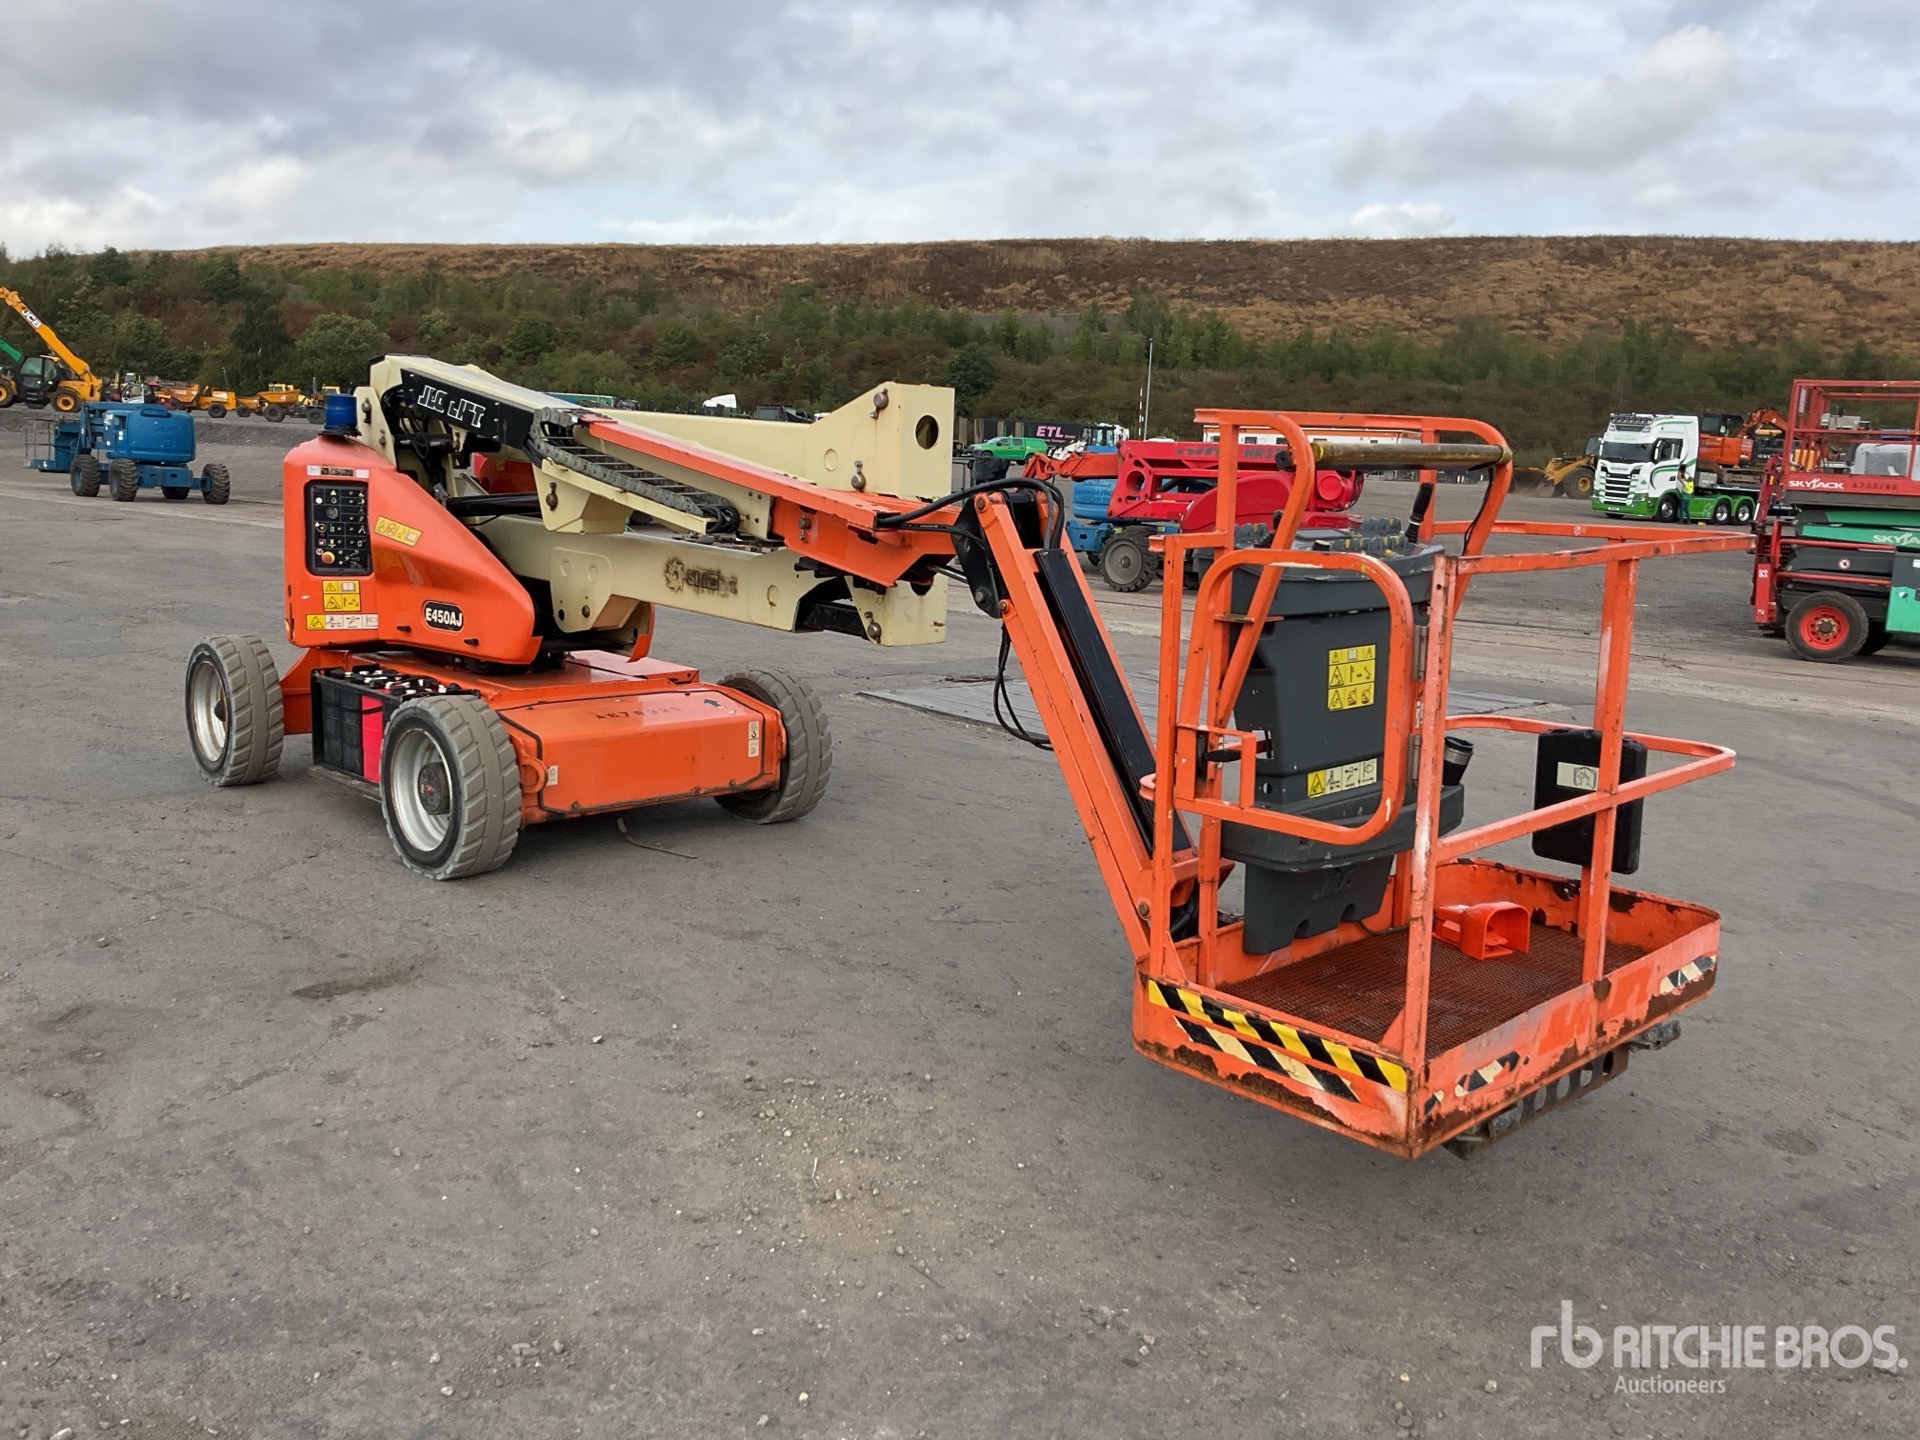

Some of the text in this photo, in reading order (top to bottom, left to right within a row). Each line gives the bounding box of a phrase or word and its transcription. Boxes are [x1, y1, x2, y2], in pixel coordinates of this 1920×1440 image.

[21, 309, 42, 328] JCB
[1036, 426, 1064, 438] ETL
[1788, 477, 1844, 489] SKYJACK
[425, 607, 463, 627] E450AJ
